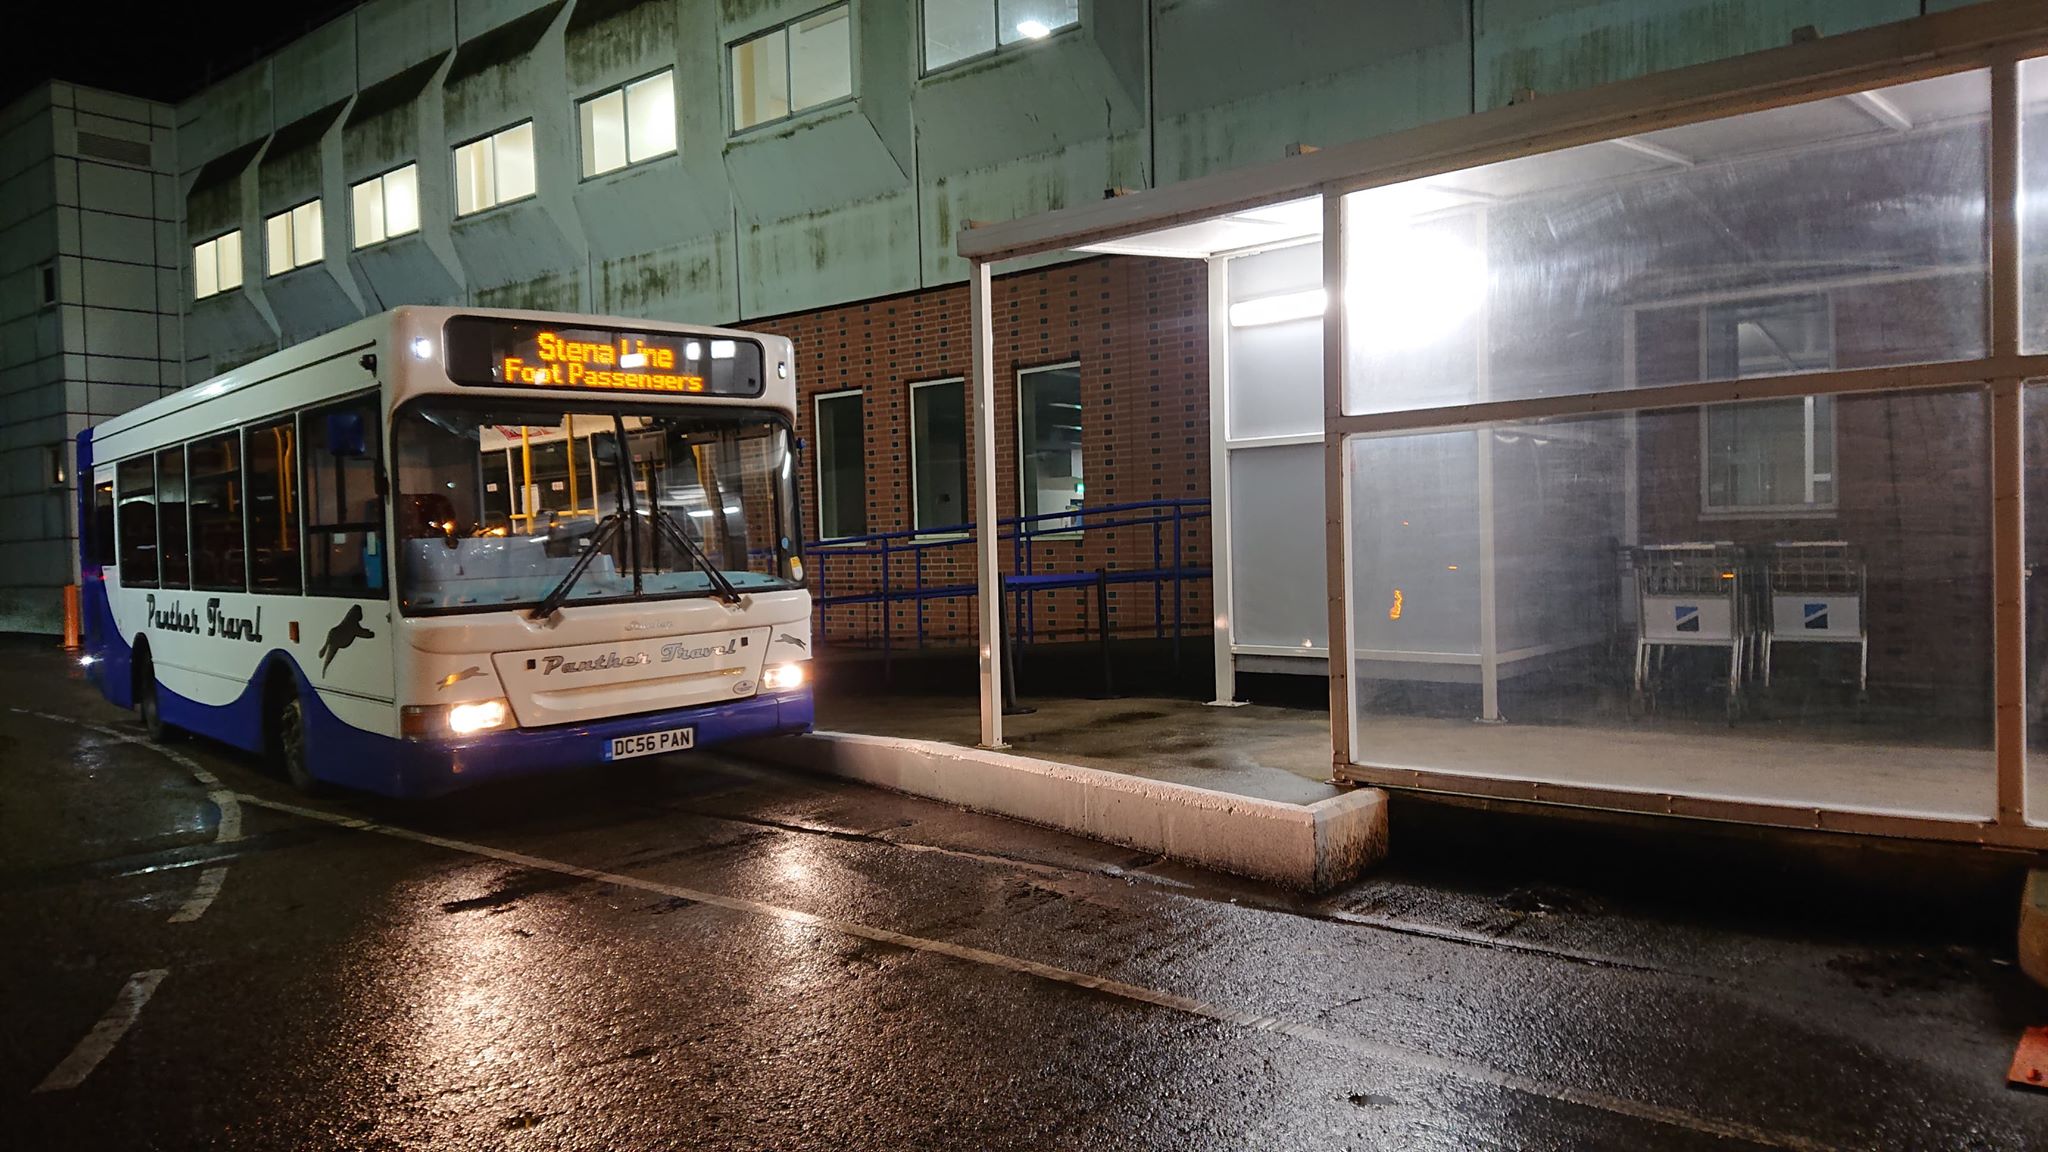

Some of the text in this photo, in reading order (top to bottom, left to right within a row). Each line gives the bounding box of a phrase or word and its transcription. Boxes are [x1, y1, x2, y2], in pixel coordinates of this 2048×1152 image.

[538, 331, 675, 369] Stena Line
[504, 357, 704, 393] Foot Passengers
[146, 593, 262, 643] Panther Travel
[542, 638, 737, 676] Panther Travel
[614, 730, 690, 756] DC56 PAN
